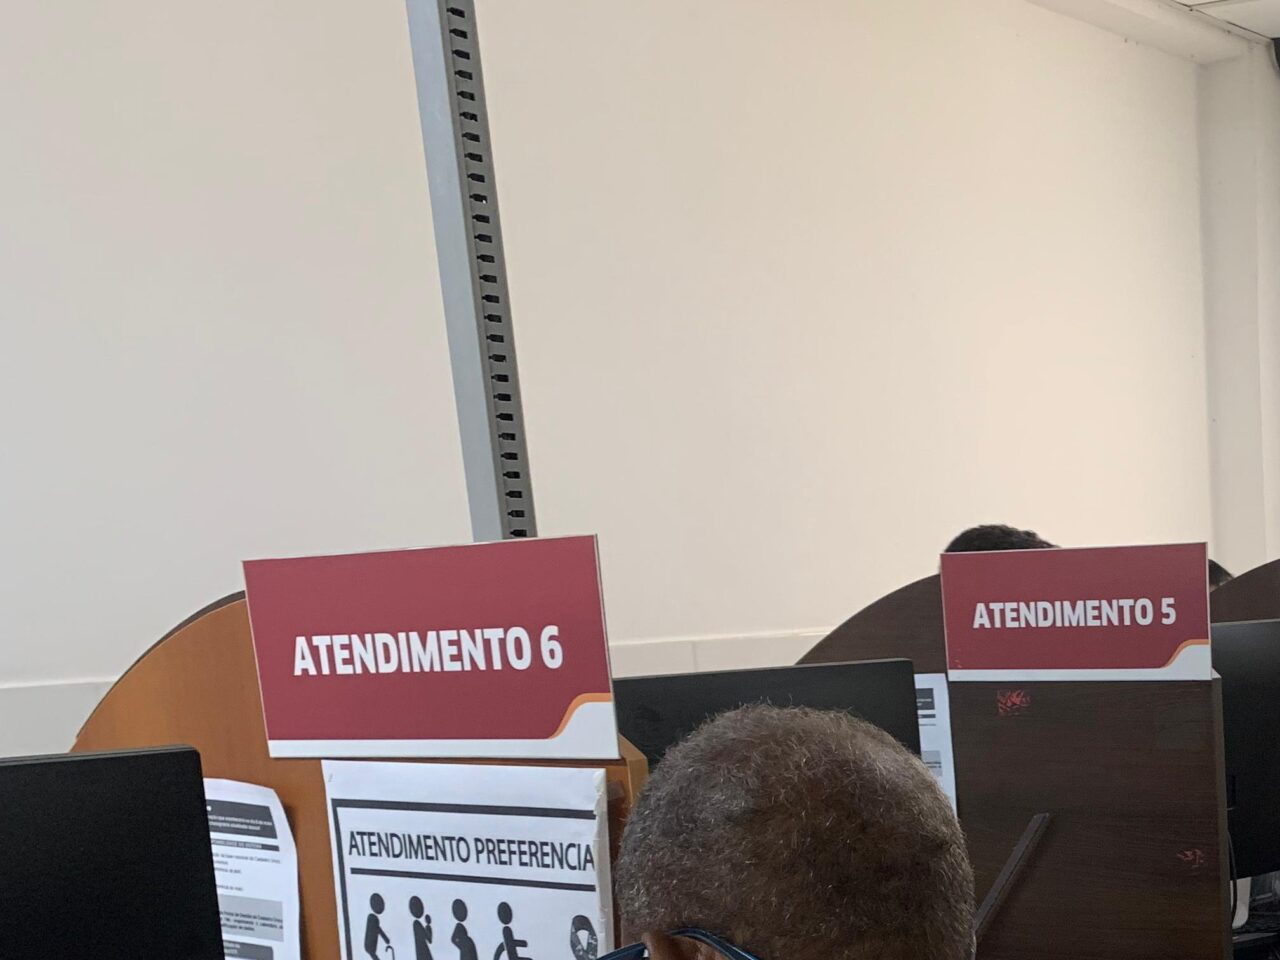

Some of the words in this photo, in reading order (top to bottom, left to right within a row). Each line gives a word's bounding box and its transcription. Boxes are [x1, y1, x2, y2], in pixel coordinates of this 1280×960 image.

[973, 598, 1154, 629] ATENDIMENTO
[1161, 597, 1177, 625] 5
[293, 626, 532, 676] ATENDIMENTO
[540, 625, 563, 669] 6
[348, 831, 471, 863] ATENDIMENTO
[473, 837, 595, 871] PREFERENCIA
